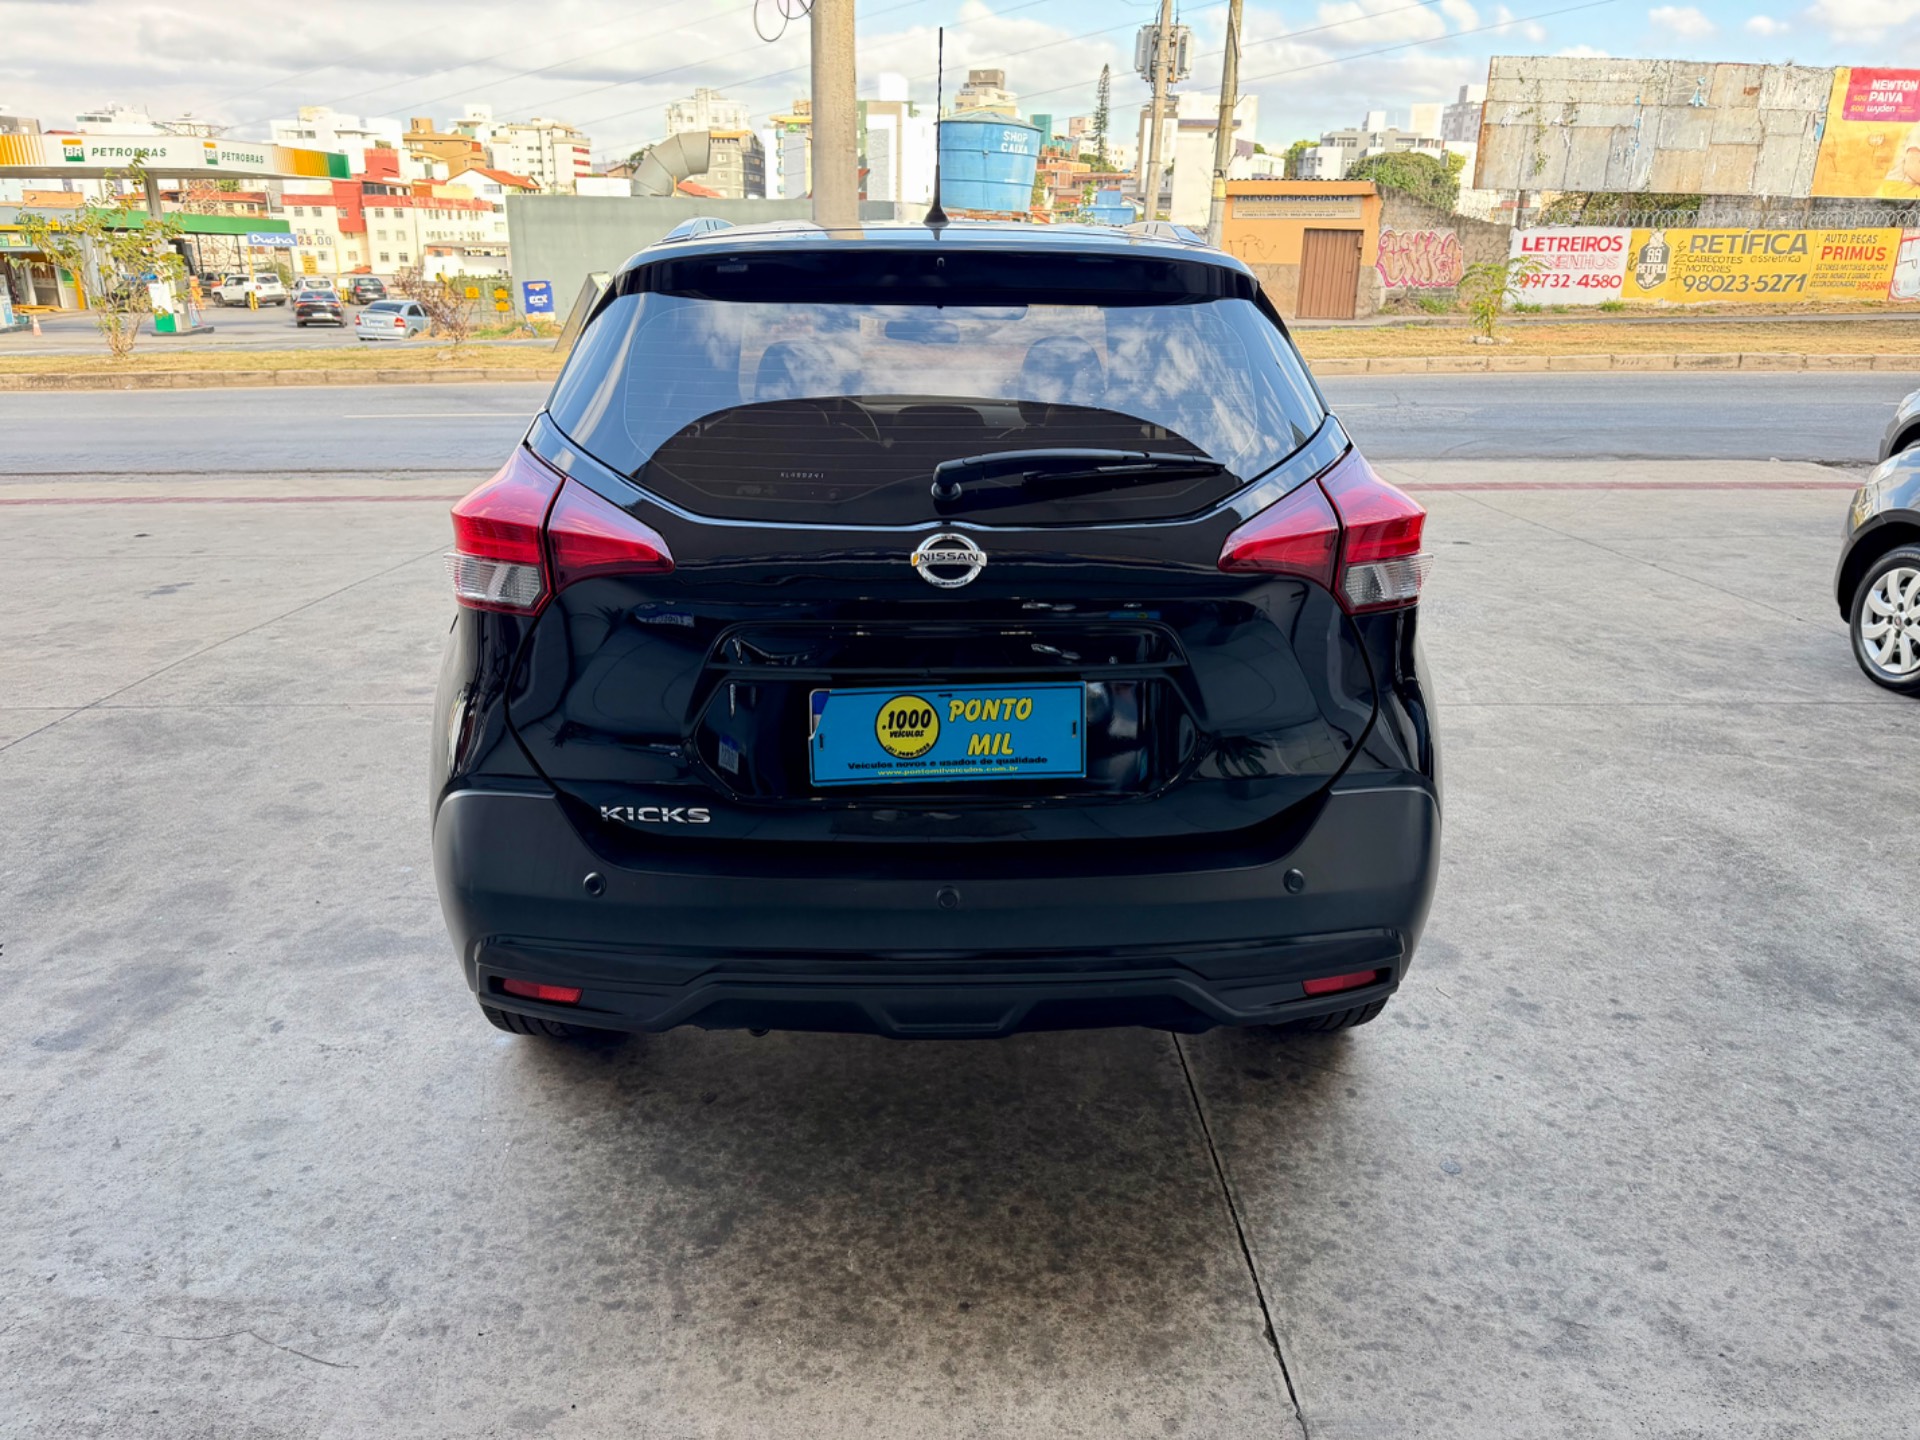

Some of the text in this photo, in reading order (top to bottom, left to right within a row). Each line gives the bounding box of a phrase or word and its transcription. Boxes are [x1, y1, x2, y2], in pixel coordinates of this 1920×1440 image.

[1871, 79, 1919, 91] NEWTON
[1869, 91, 1903, 103] PAIVA
[1003, 131, 1028, 142] SHOP
[91, 147, 167, 158] PETROBRAS
[1001, 143, 1028, 154] CAIXA
[221, 151, 265, 165] PETROBRAS
[250, 233, 295, 245] Ducha
[1521, 235, 1623, 252] LETREIROS
[1690, 228, 1808, 255] RETÍFICA
[1824, 234, 1848, 243] AUTO
[1820, 246, 1887, 261] PRIMUS
[1521, 254, 1619, 270] SENHOS
[1683, 273, 1808, 294] 98023-5271
[919, 551, 980, 562] NISSAN
[949, 697, 1034, 722] PONTO
[967, 732, 1014, 756] MIL
[940, 758, 977, 766] usados
[996, 756, 1048, 766] qualidade
[600, 806, 711, 823] KICKS
